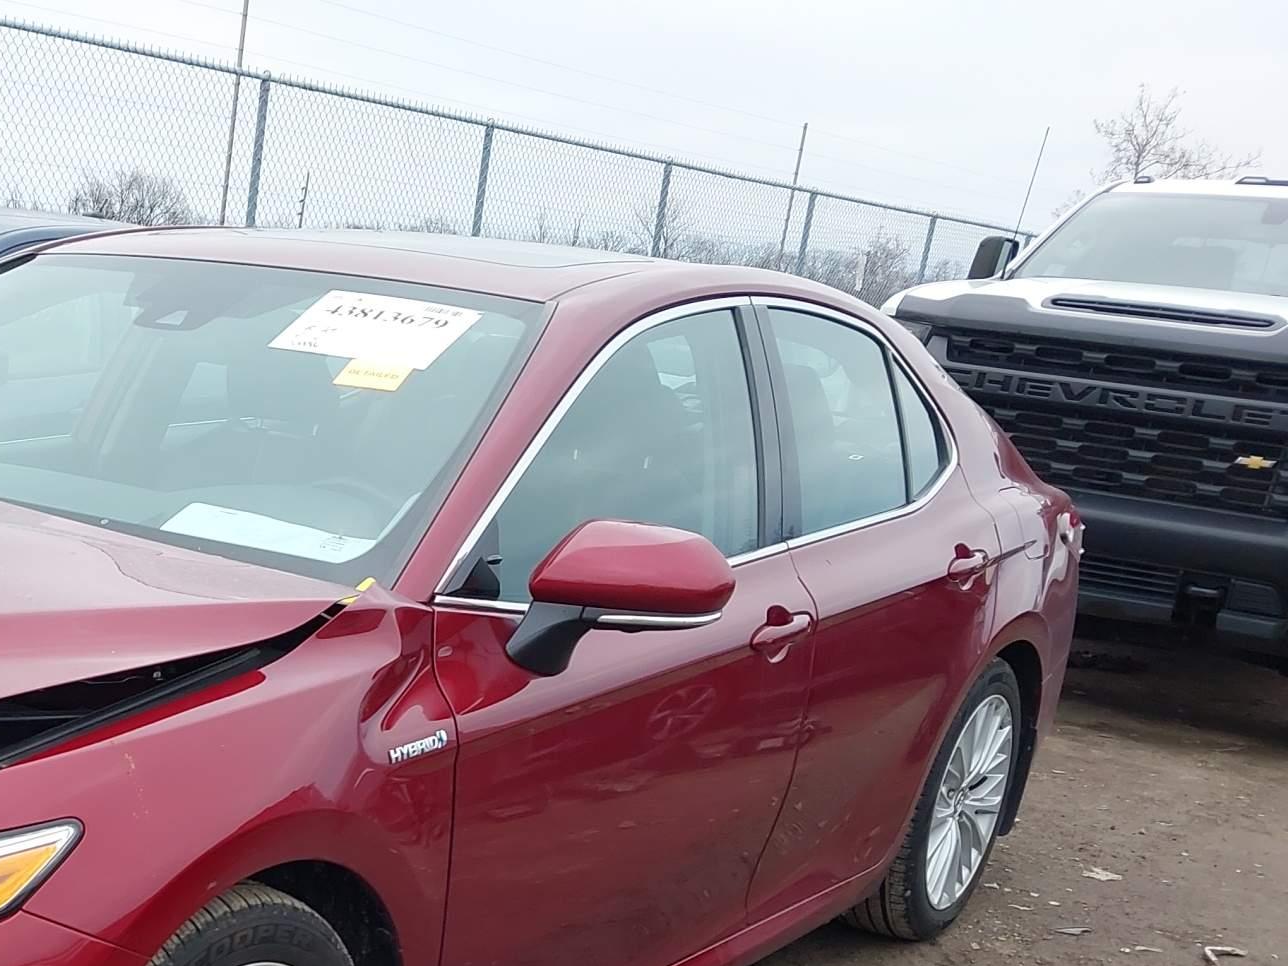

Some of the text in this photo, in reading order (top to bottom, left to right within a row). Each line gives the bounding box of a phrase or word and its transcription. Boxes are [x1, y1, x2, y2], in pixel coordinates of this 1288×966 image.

[326, 303, 449, 329] 43813679
[943, 366, 1288, 426] HEVROLE
[389, 735, 439, 764] HYBRID
